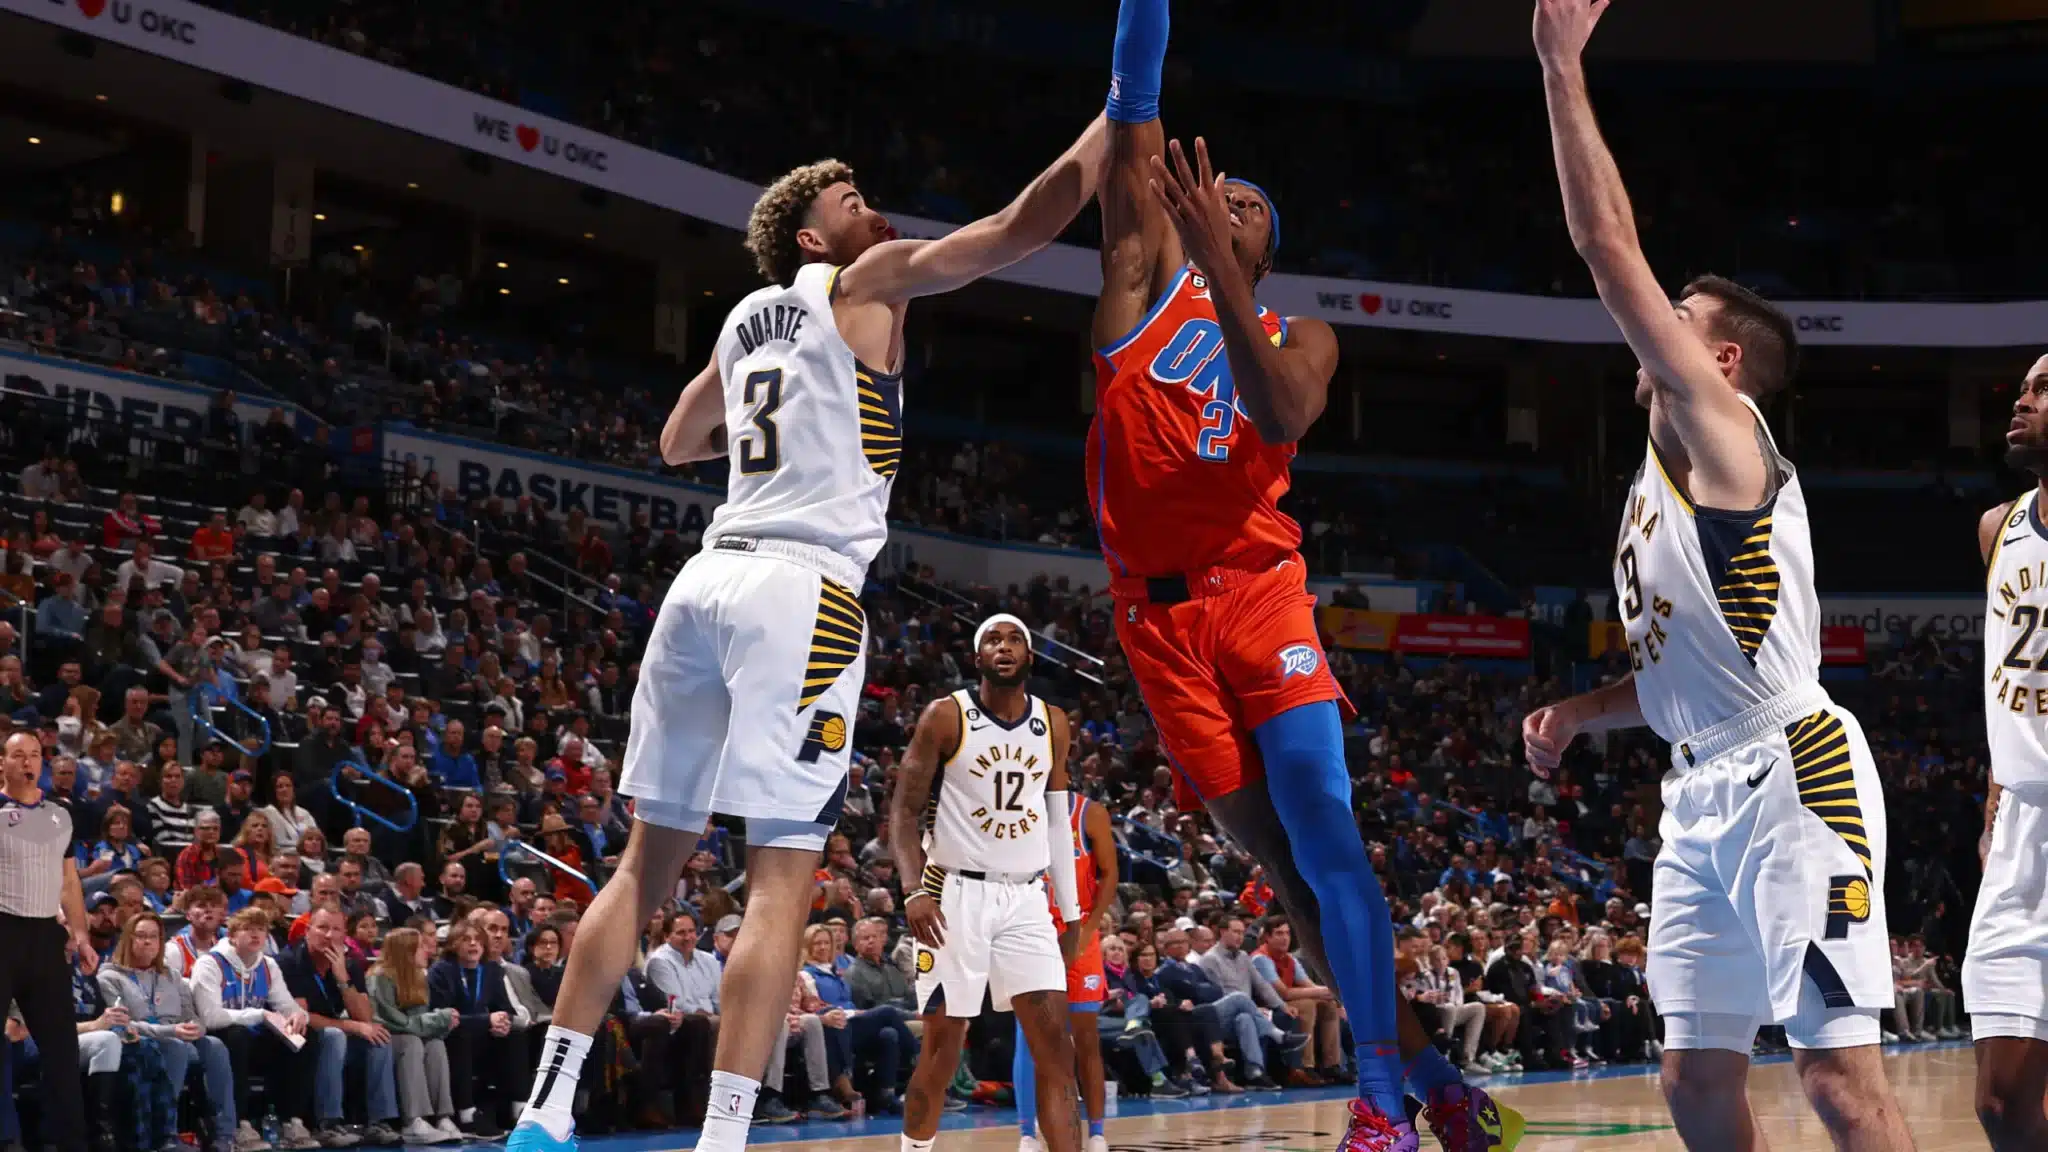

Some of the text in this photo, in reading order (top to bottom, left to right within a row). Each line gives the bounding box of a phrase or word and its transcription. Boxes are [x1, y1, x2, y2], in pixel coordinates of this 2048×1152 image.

[140, 9, 197, 45] OKC
[473, 111, 608, 172] WE U OKC
[1193, 275, 1206, 288] 6
[1317, 292, 1453, 319] WE U OKC
[1798, 315, 1844, 332] OKC
[736, 304, 808, 356] DUARTE
[740, 366, 783, 477] 3
[1196, 400, 1235, 464] 2
[2011, 512, 2024, 526] 6
[968, 709, 979, 721] 6
[969, 743, 1044, 782] INDIANA
[993, 771, 1025, 811] 12
[971, 807, 1039, 840] PACERS
